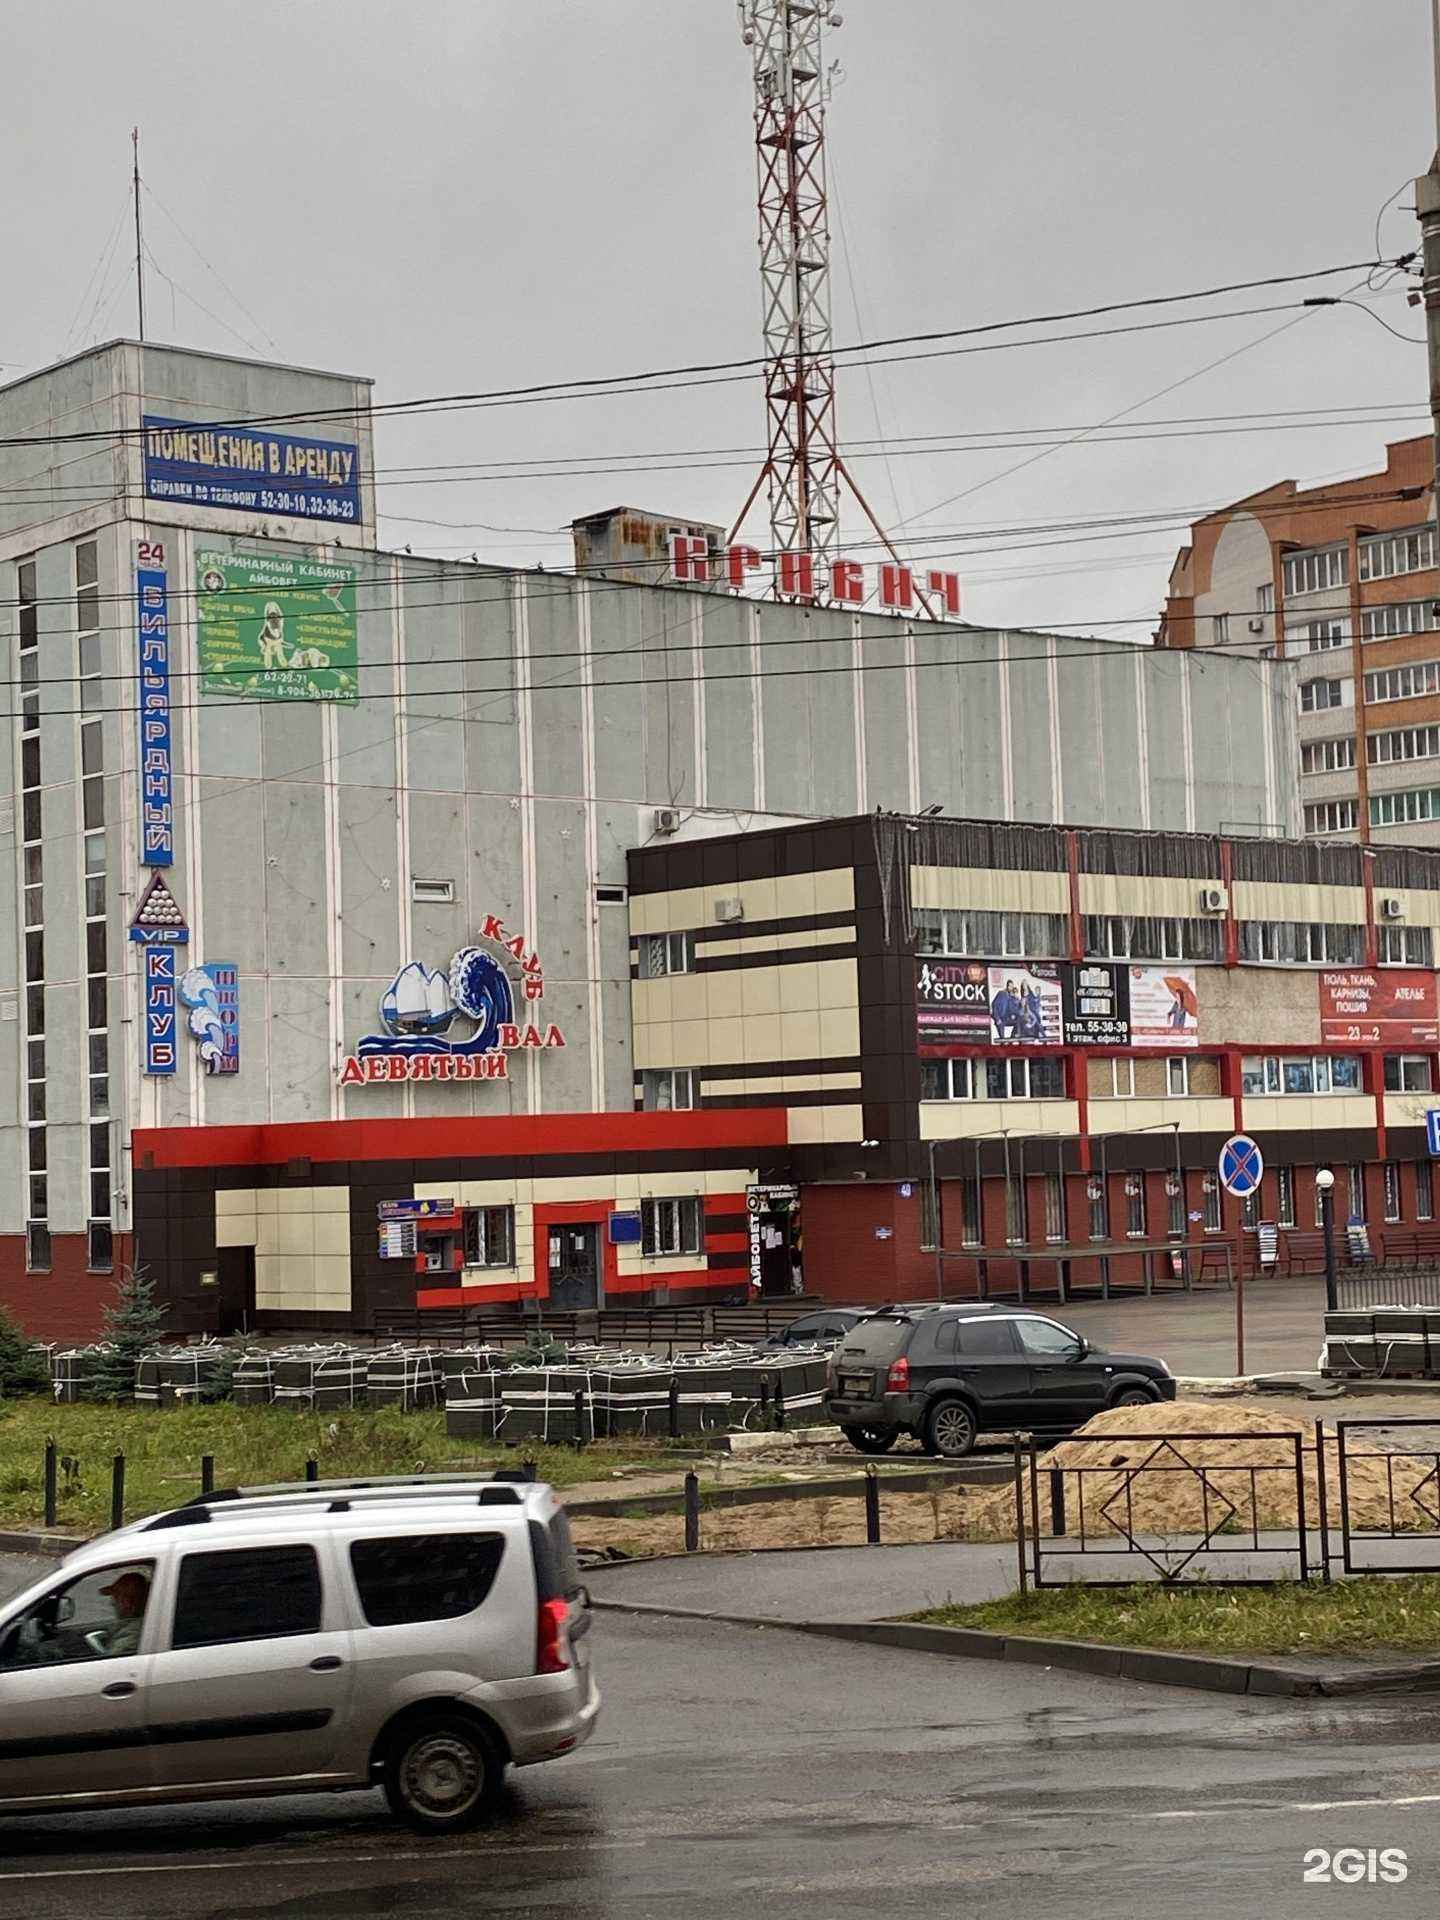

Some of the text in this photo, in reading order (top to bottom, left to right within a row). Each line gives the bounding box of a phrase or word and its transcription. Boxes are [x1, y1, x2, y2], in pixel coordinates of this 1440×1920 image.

[147, 426, 353, 485] ПОМЕЩЕНИЯ В АРЕНДУ
[138, 542, 164, 561] 24
[201, 552, 353, 581] ВЕТЕРИНАРНЫЙ КАБИНЕТ
[141, 586, 171, 852] БИЛЬЯРДНЫЙ
[479, 914, 545, 1001] КЛУБ
[934, 966, 967, 983] CITY
[149, 954, 174, 1066] КЛУБ
[934, 983, 986, 1000] STOCK
[340, 1023, 566, 1087] ДЕВЯТЫЙ ВАЛ
